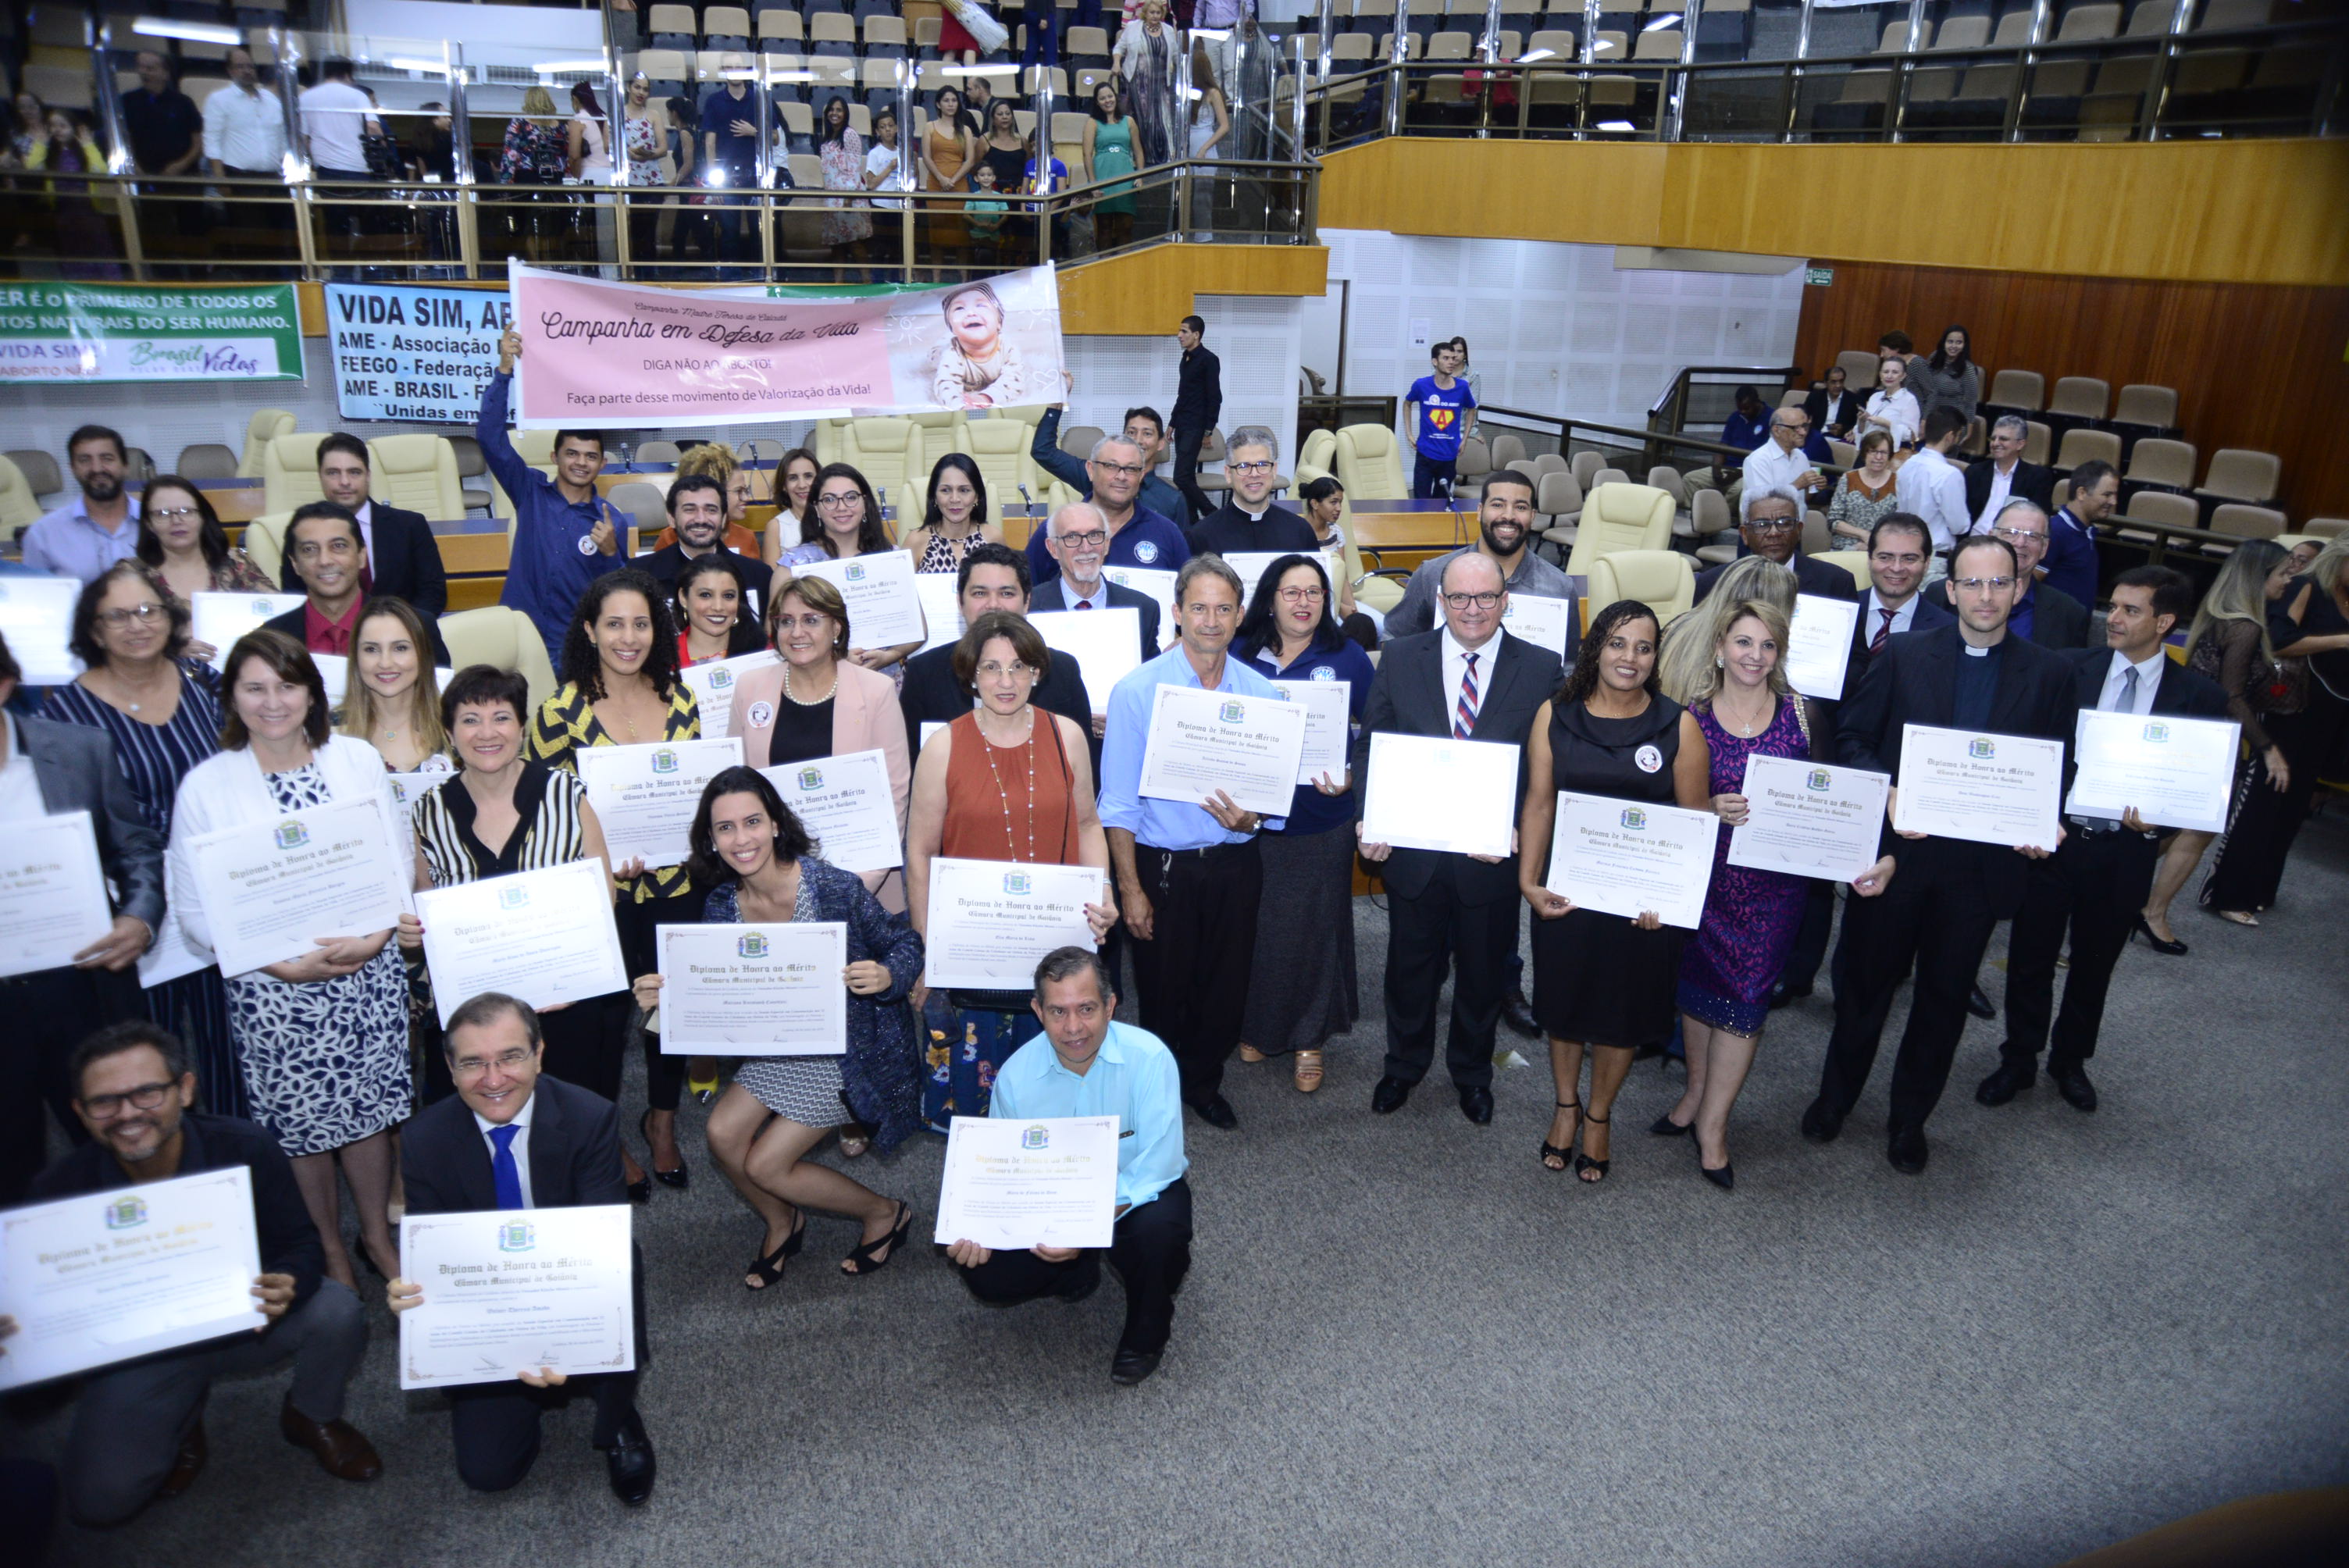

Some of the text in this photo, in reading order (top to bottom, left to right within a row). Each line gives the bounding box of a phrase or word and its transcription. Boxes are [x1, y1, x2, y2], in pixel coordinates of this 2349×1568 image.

[30, 291, 43, 306] É
[46, 295, 62, 307] O
[69, 294, 158, 308] PRIMEIRO
[161, 296, 185, 308] DE
[189, 296, 250, 308] TODOS
[253, 296, 276, 308] OS
[40, 315, 134, 330] NATURAIS
[137, 317, 165, 330] DO
[169, 317, 202, 329] SER
[205, 316, 291, 329] HUMANO.
[337, 294, 406, 325] VIDA
[414, 297, 471, 334] SIM,
[541, 312, 860, 348] Campanha em Defesa da Vida
[339, 332, 375, 350] AME
[392, 334, 491, 358] Associação
[130, 341, 258, 374] Brasil Vidas
[341, 355, 397, 374] FEEGO
[643, 359, 672, 370] DIGA
[675, 358, 700, 370] NÃO
[344, 380, 378, 397] AME
[394, 381, 458, 400] BRASIL
[567, 384, 871, 406] Faça parte desse movimento de Valorização da Vida!
[1177, 721, 1207, 732] Diploma
[1220, 727, 1242, 737] Honra
[1255, 733, 1280, 743] Mérito
[1185, 733, 1207, 742] Câmara
[1210, 737, 1237, 747] Municipal
[1927, 758, 1957, 768] Diploma
[1971, 763, 1994, 772] Honra
[2009, 768, 2034, 777] Mérito
[694, 776, 711, 785] Mér
[841, 789, 865, 799] Mérito
[1767, 788, 1795, 800] Diploma
[1807, 795, 1827, 804] Honra
[1840, 800, 1862, 811] Mérito
[1581, 827, 1609, 839] Diploma
[1623, 833, 1644, 844] Honra
[1658, 839, 1684, 850] Mérito
[229, 864, 269, 881] Diploma
[286, 851, 315, 867] Honra
[332, 839, 363, 853] Mérito
[957, 898, 991, 909] Diploma
[1006, 900, 1031, 911] Honra
[1046, 903, 1074, 912] Mérito
[996, 912, 1026, 921] Municipal
[1037, 914, 1061, 922] Goiânia
[690, 964, 725, 975] Diploma
[729, 964, 738, 973] de
[743, 964, 769, 974] Honra
[786, 963, 816, 972] Mérito
[1064, 1155, 1091, 1164] Mérito
[438, 1256, 593, 1276] Diploma de Honra ao Mérito
[454, 1278, 487, 1288] Câmara
[490, 1274, 531, 1286] Municipal
